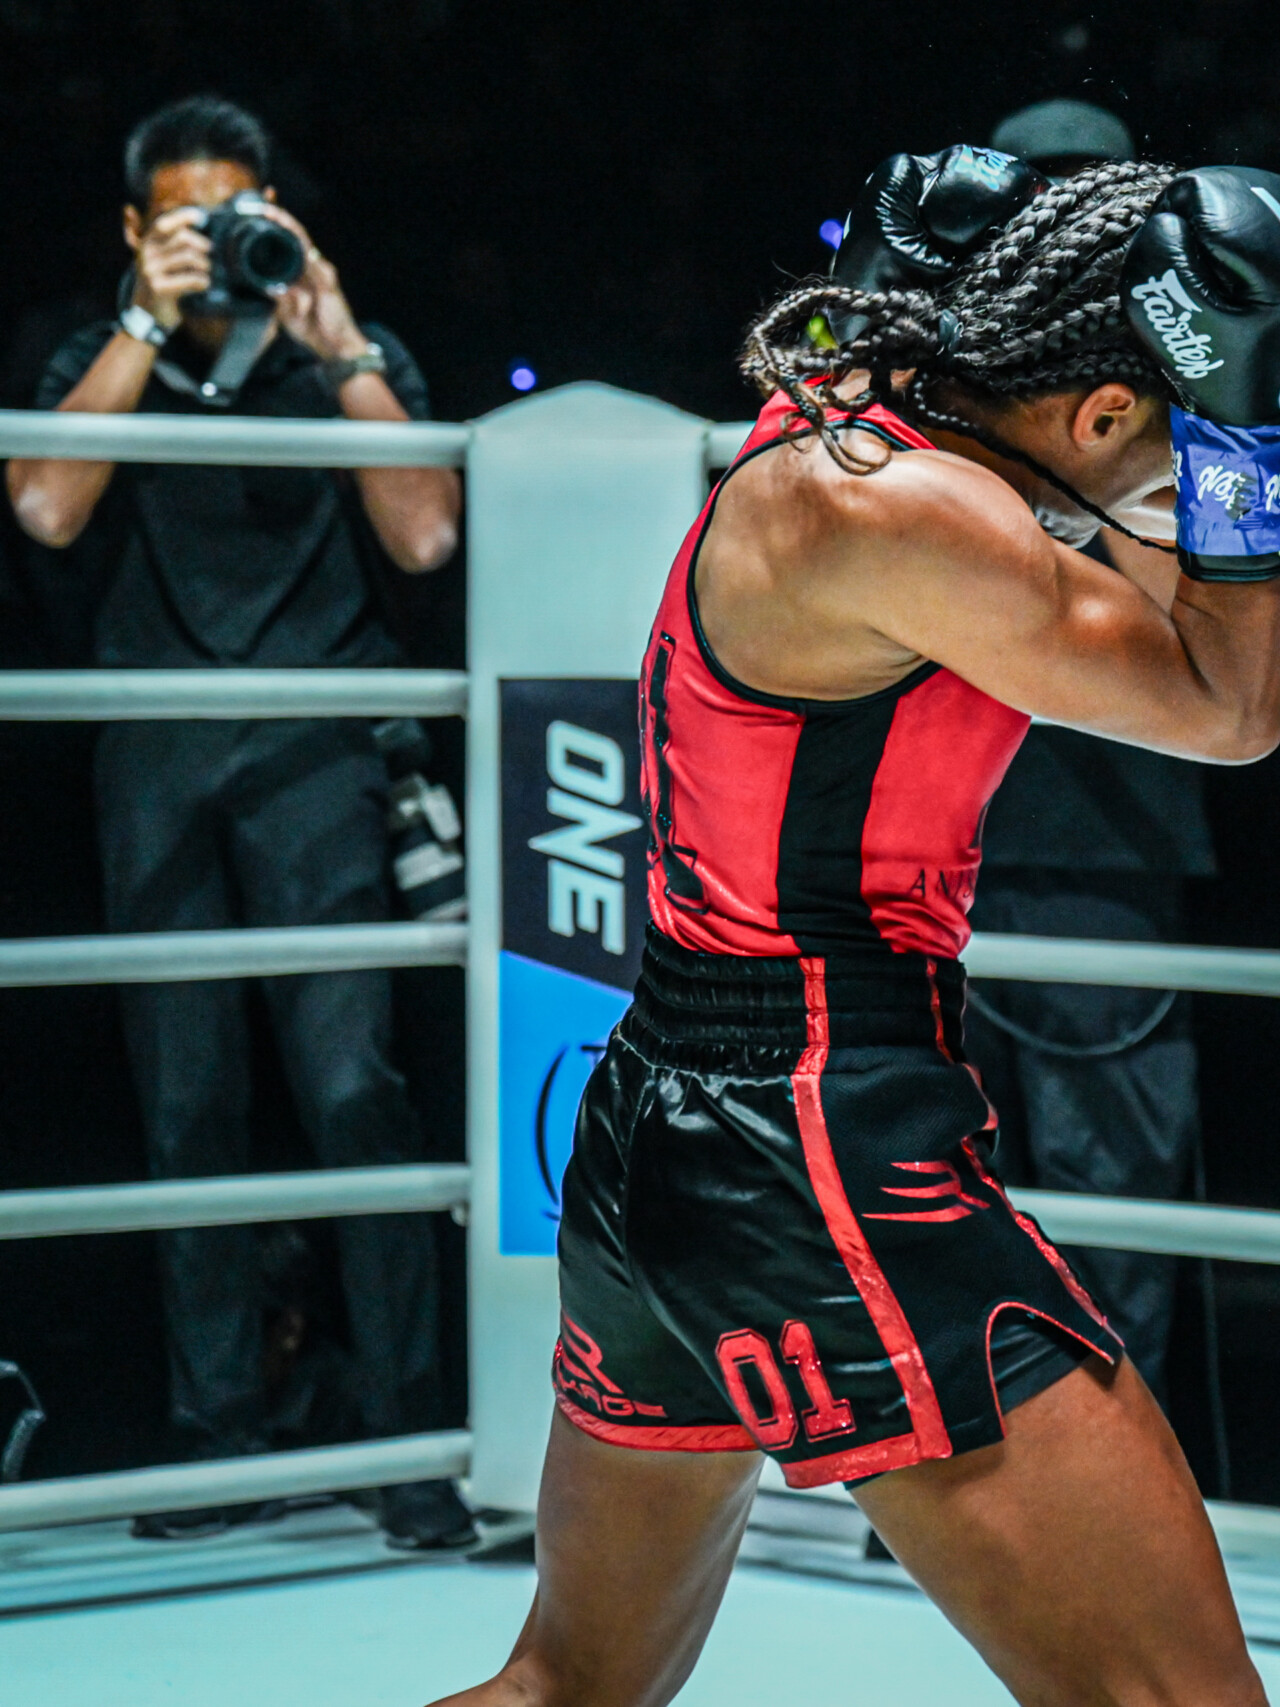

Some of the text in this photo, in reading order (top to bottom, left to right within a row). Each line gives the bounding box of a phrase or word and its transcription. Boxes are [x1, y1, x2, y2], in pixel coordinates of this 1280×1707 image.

[1131, 268, 1225, 379] Fairtex
[527, 719, 643, 956] ONE
[715, 1319, 857, 1451] 01
